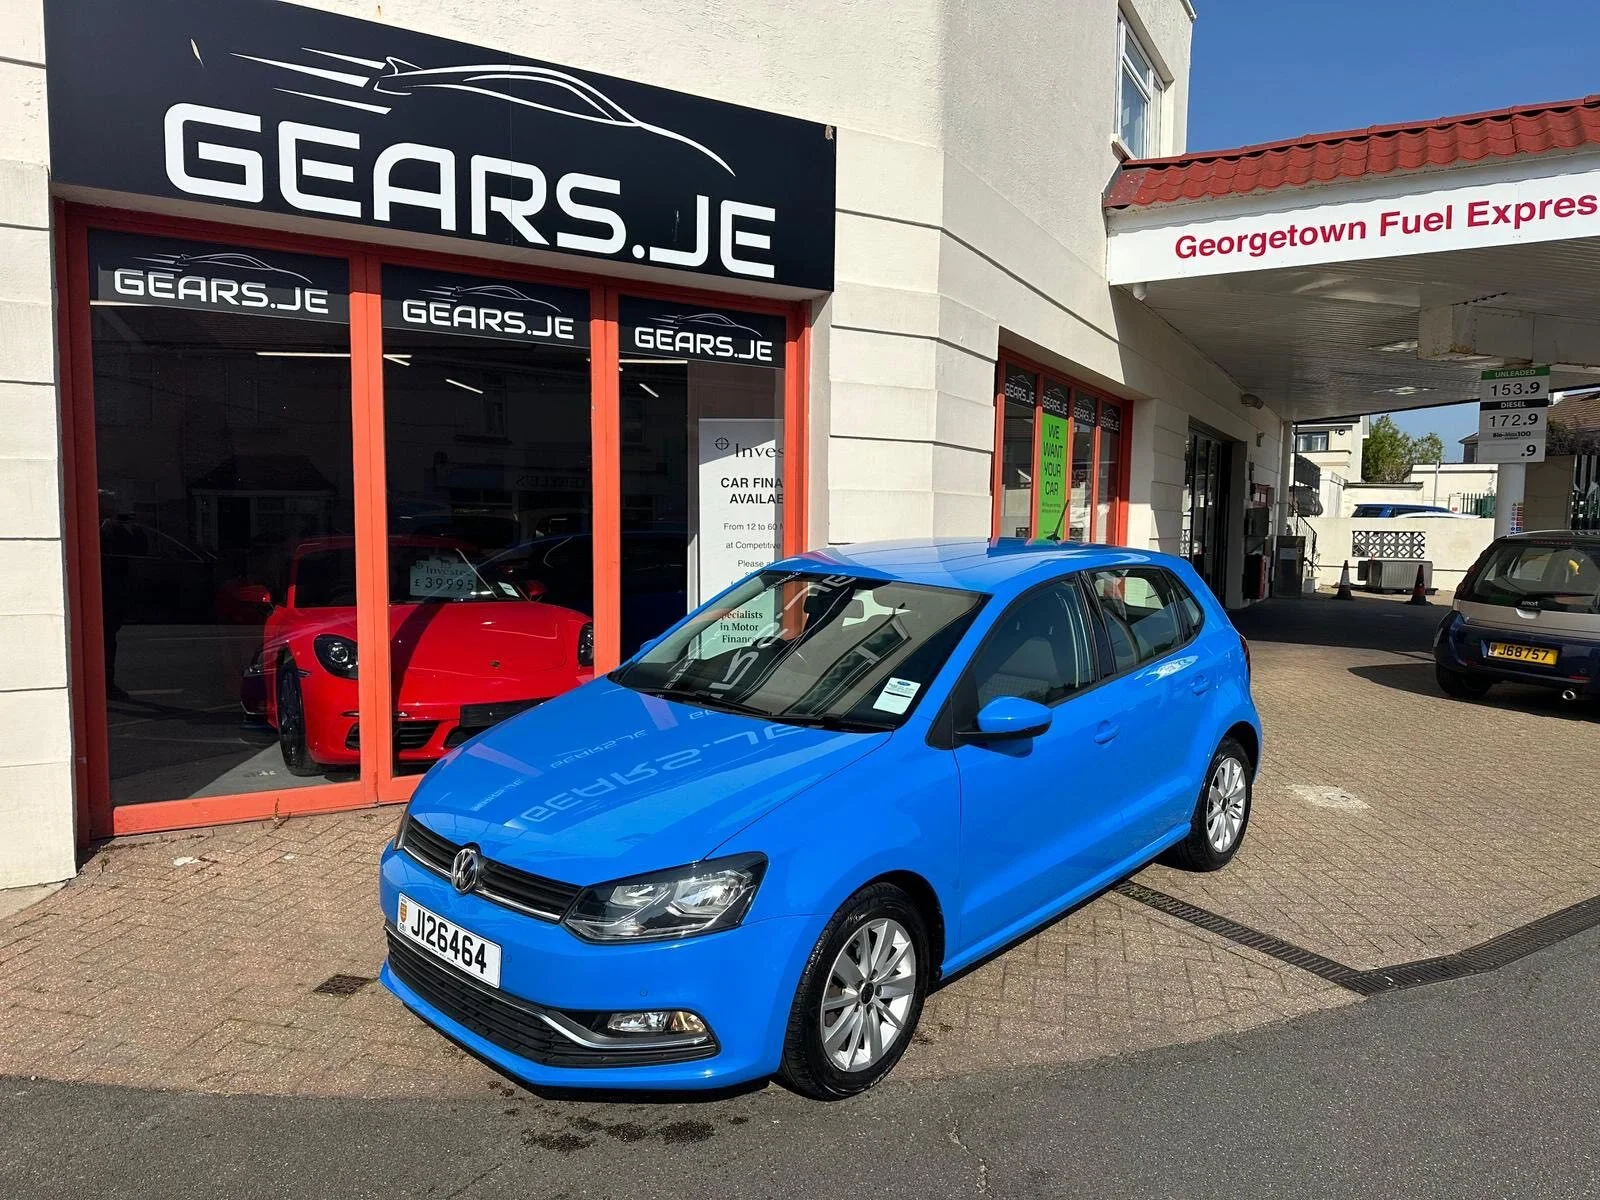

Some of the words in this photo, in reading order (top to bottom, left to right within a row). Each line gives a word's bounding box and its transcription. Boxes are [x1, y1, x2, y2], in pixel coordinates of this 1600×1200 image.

[164, 103, 776, 278] GEARS.JE
[1175, 221, 1367, 258] Georgetown
[1380, 205, 1453, 237] Fuel
[1466, 193, 1599, 230] Expres
[114, 270, 329, 314] GEARS.JE
[402, 299, 575, 340] GEARS.JE
[634, 327, 773, 363] GEARS.JE
[1495, 369, 1536, 378] UNLEADED
[1491, 381, 1541, 396] 153.9
[1500, 400, 1526, 409] DIESEL
[1489, 413, 1539, 427] 172.9
[1048, 424, 1060, 440] WE
[1043, 441, 1064, 459] WANT
[1044, 462, 1062, 478] YOUR
[721, 477, 749, 488] CAR
[1045, 480, 1060, 497] CAR
[723, 522, 744, 531] From
[747, 522, 756, 531] 12
[758, 522, 766, 531] to
[767, 522, 778, 531] 60
[725, 541, 733, 549] at
[735, 541, 781, 552] Competitive
[737, 560, 764, 568] Please
[720, 623, 730, 631] in
[732, 623, 759, 631] Motor
[1499, 643, 1549, 661] J68757
